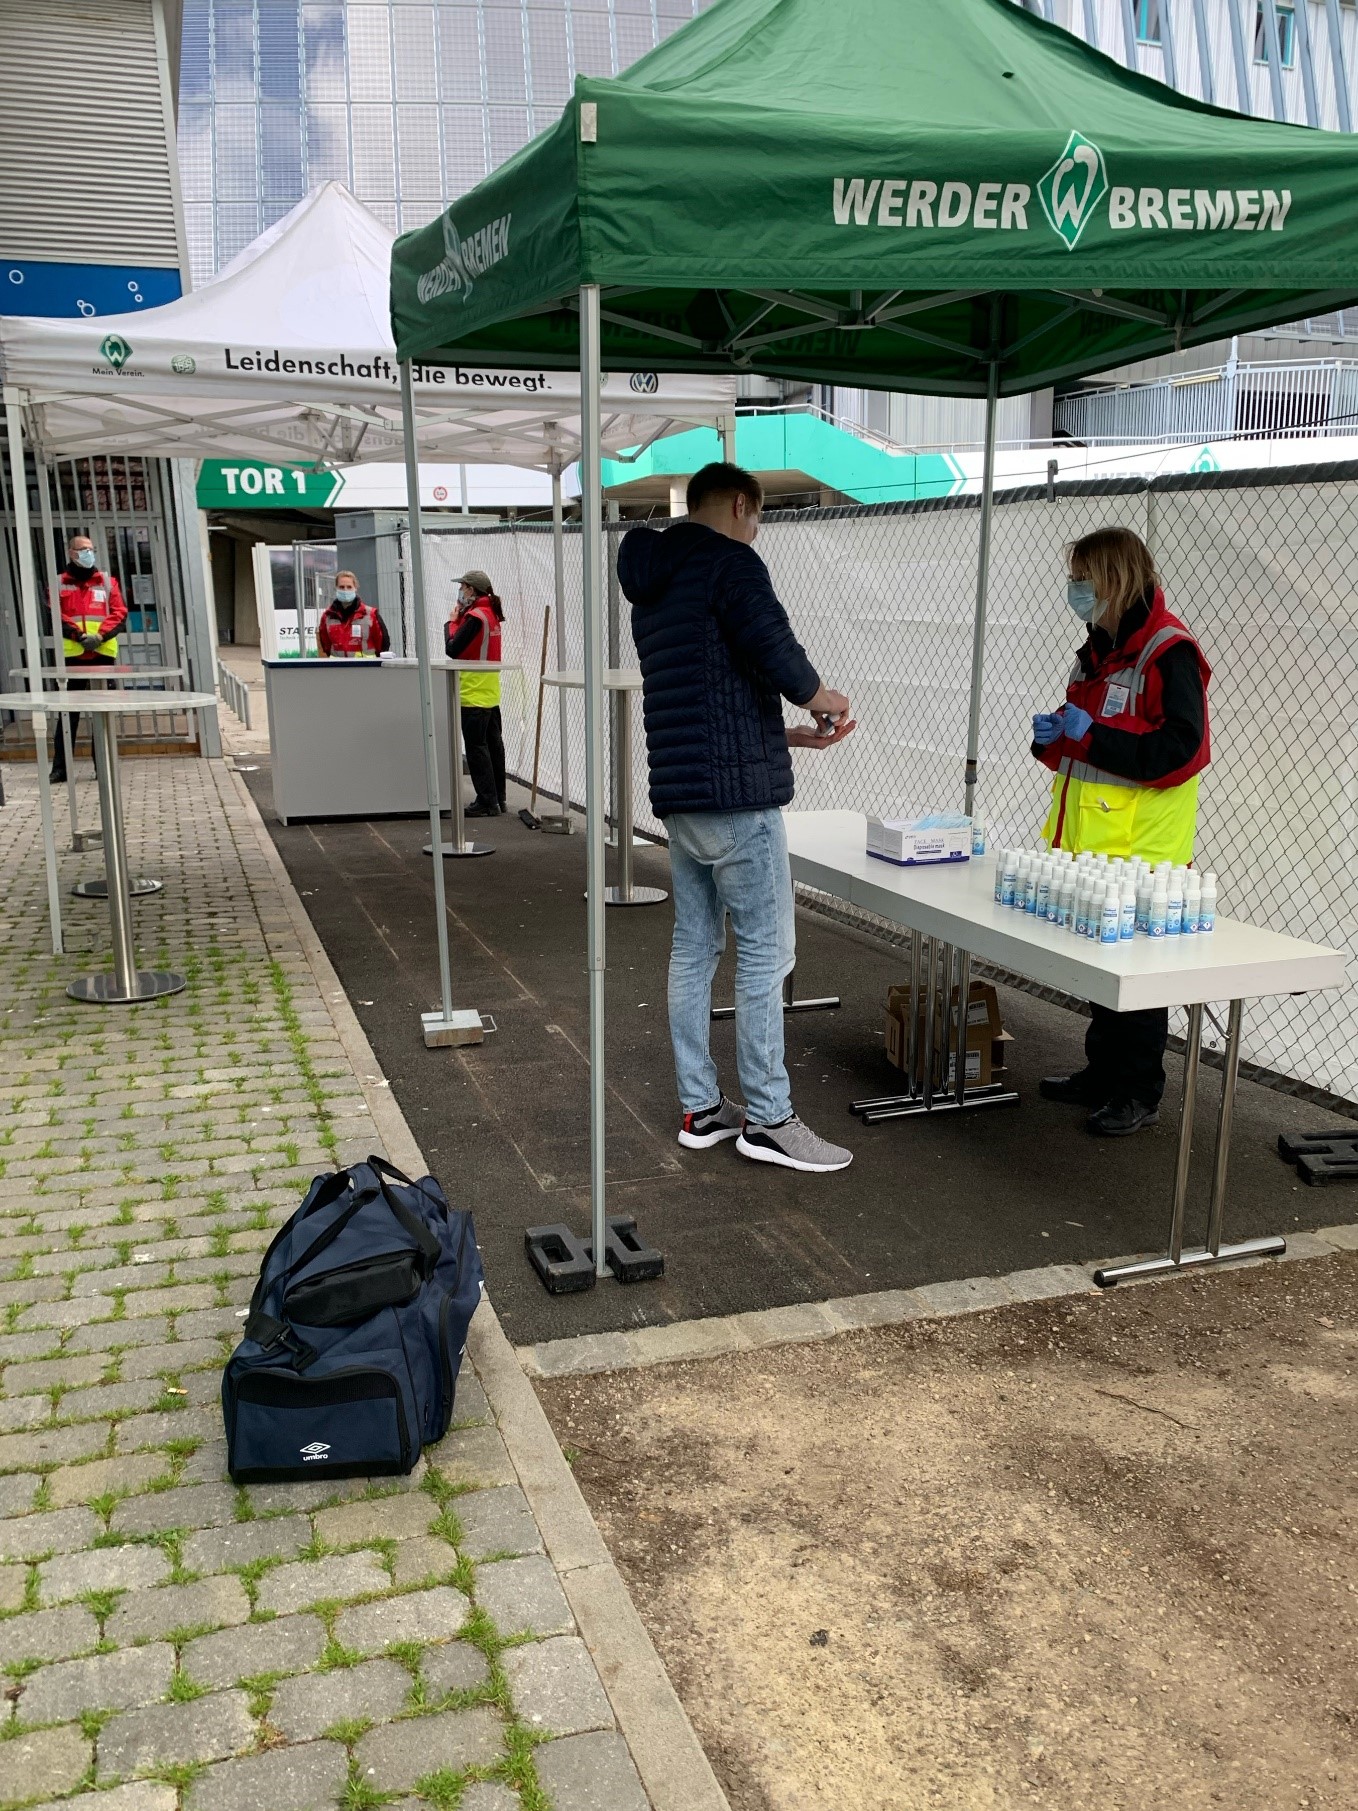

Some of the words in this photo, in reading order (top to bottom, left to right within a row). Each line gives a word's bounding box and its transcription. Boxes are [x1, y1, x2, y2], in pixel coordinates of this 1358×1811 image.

[832, 177, 1032, 230] WERDER
[1108, 186, 1292, 232] BREMEN
[460, 213, 512, 279] BREMEN
[92, 367, 114, 376] Mein
[116, 368, 145, 377] Verein.
[223, 348, 398, 384] Leidenschaft,
[413, 365, 446, 384] die
[454, 366, 553, 392] bewegt.
[220, 467, 285, 495] TOR
[291, 470, 306, 494] 1
